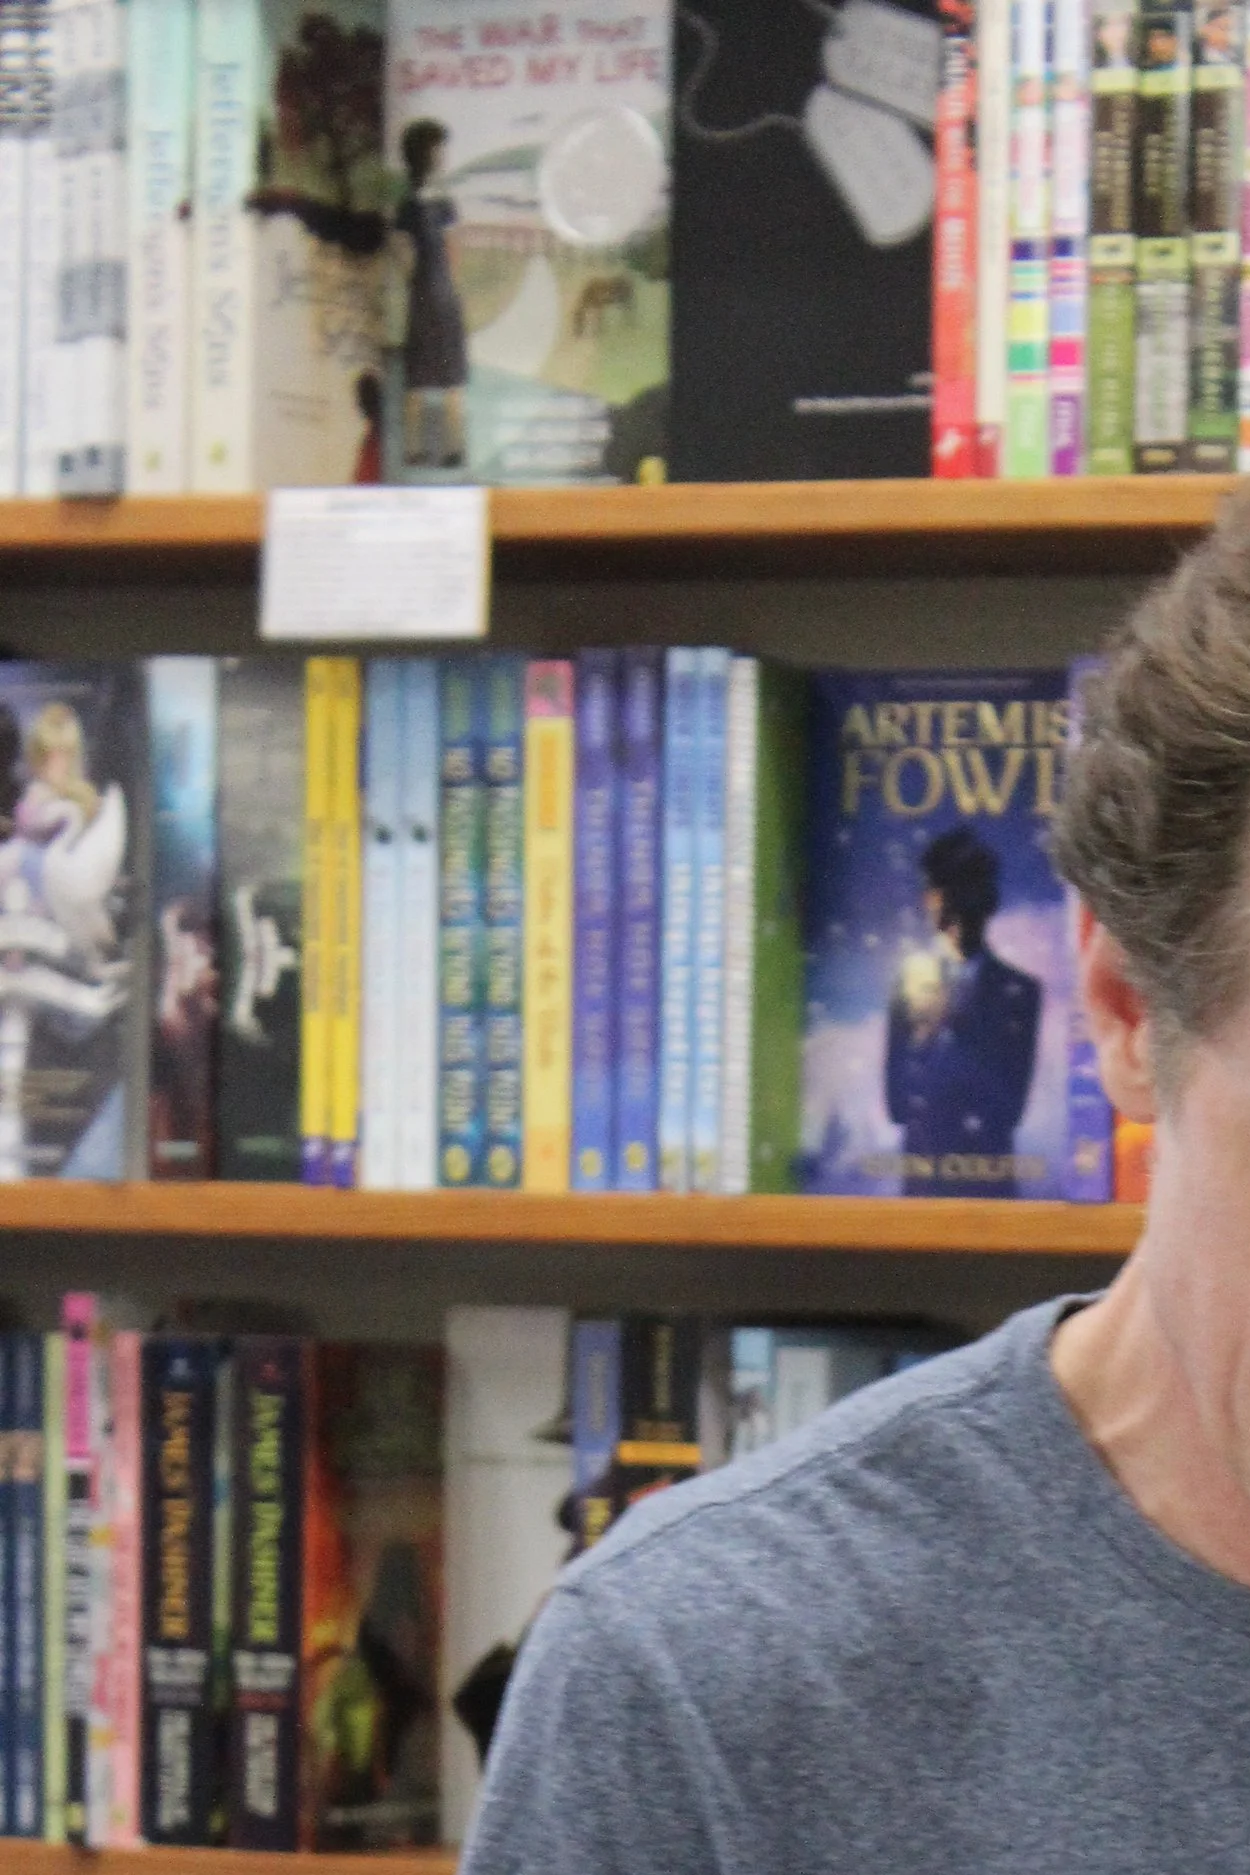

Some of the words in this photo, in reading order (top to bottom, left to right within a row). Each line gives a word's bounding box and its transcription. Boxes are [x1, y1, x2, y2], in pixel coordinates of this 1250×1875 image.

[479, 14, 561, 48] WAR
[395, 55, 515, 95] SAVED
[594, 47, 661, 83] LIFE
[841, 700, 1070, 747] ARTEMIS
